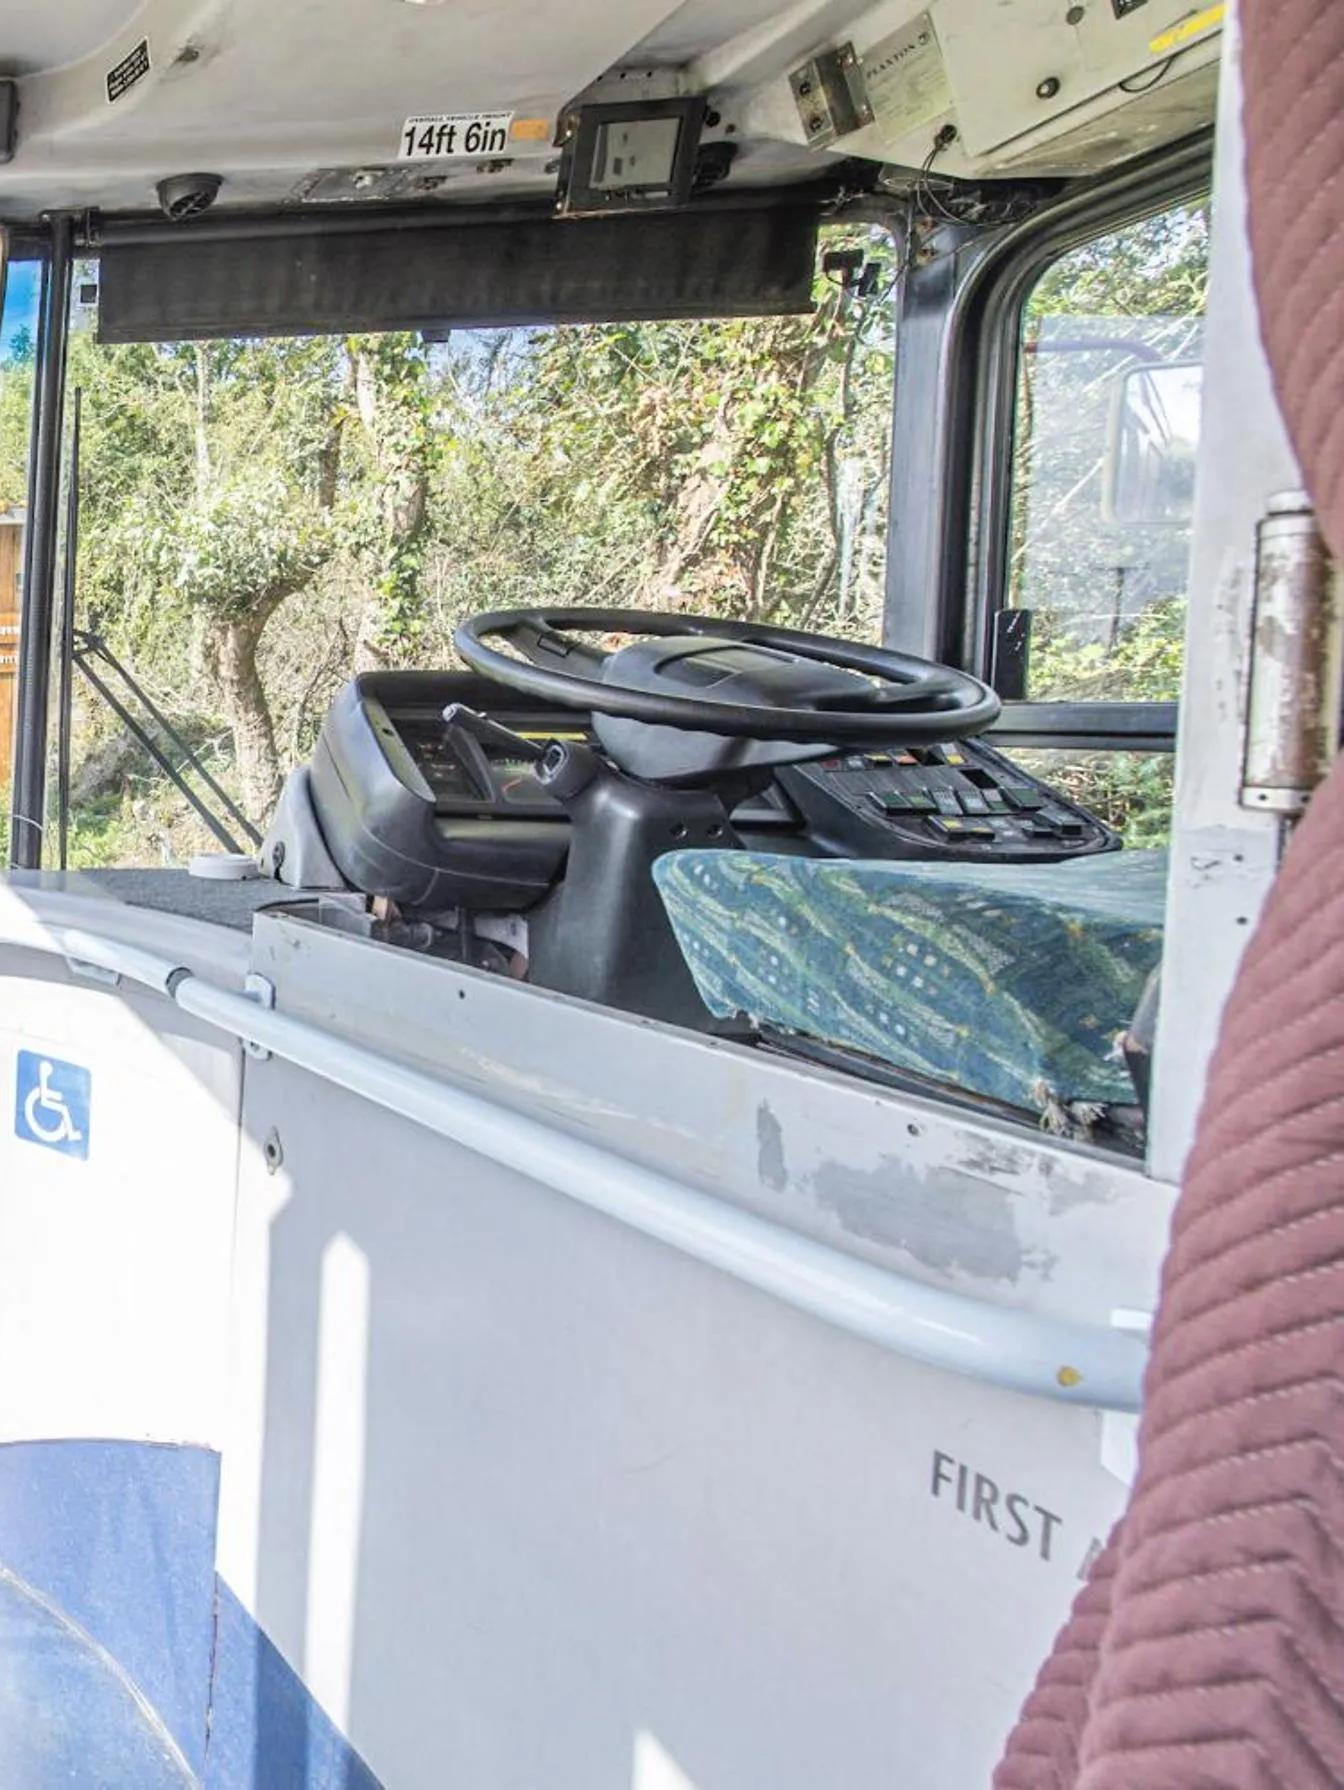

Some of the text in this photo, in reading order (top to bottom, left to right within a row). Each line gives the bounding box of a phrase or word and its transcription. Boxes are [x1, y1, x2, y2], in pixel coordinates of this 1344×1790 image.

[404, 121, 506, 156] 14ft 6in
[931, 1449, 1062, 1562] FIRST
